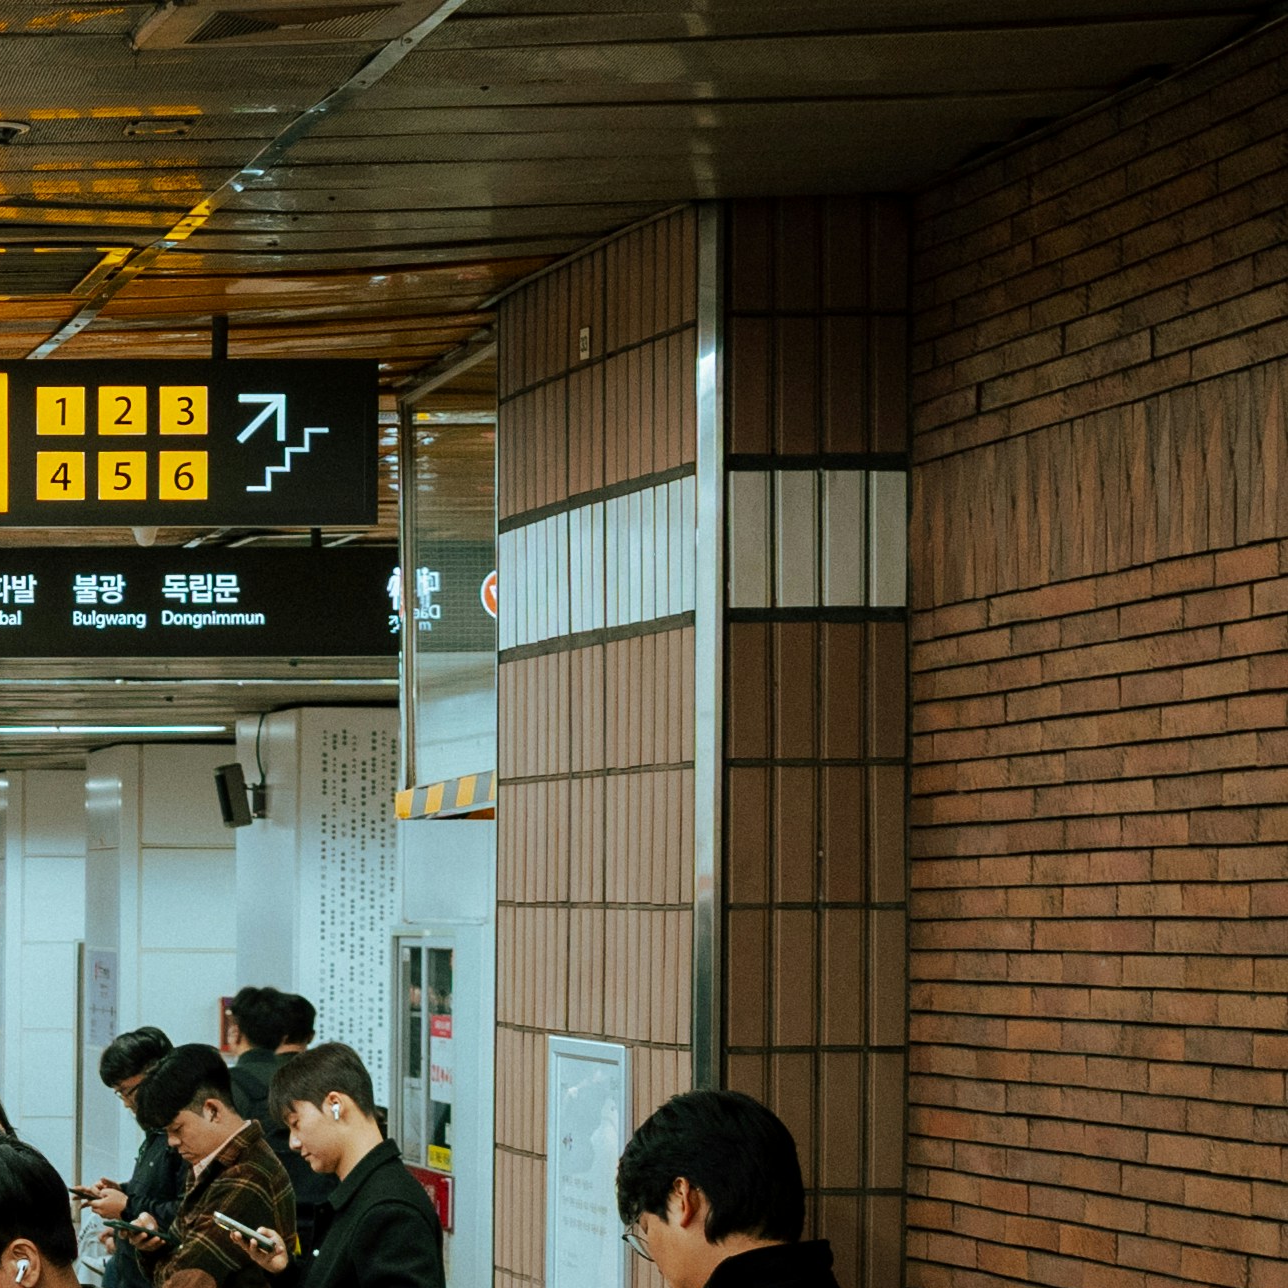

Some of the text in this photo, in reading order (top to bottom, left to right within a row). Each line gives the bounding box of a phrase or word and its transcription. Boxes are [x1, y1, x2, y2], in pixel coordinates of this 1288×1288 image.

[55, 396, 195, 426] 1 2 3
[50, 461, 194, 491] 4 5 6
[72, 573, 126, 604] 불광
[161, 573, 241, 604] 독립문
[72, 609, 147, 629] Bulgwang
[161, 609, 265, 630] Dongnimmun
